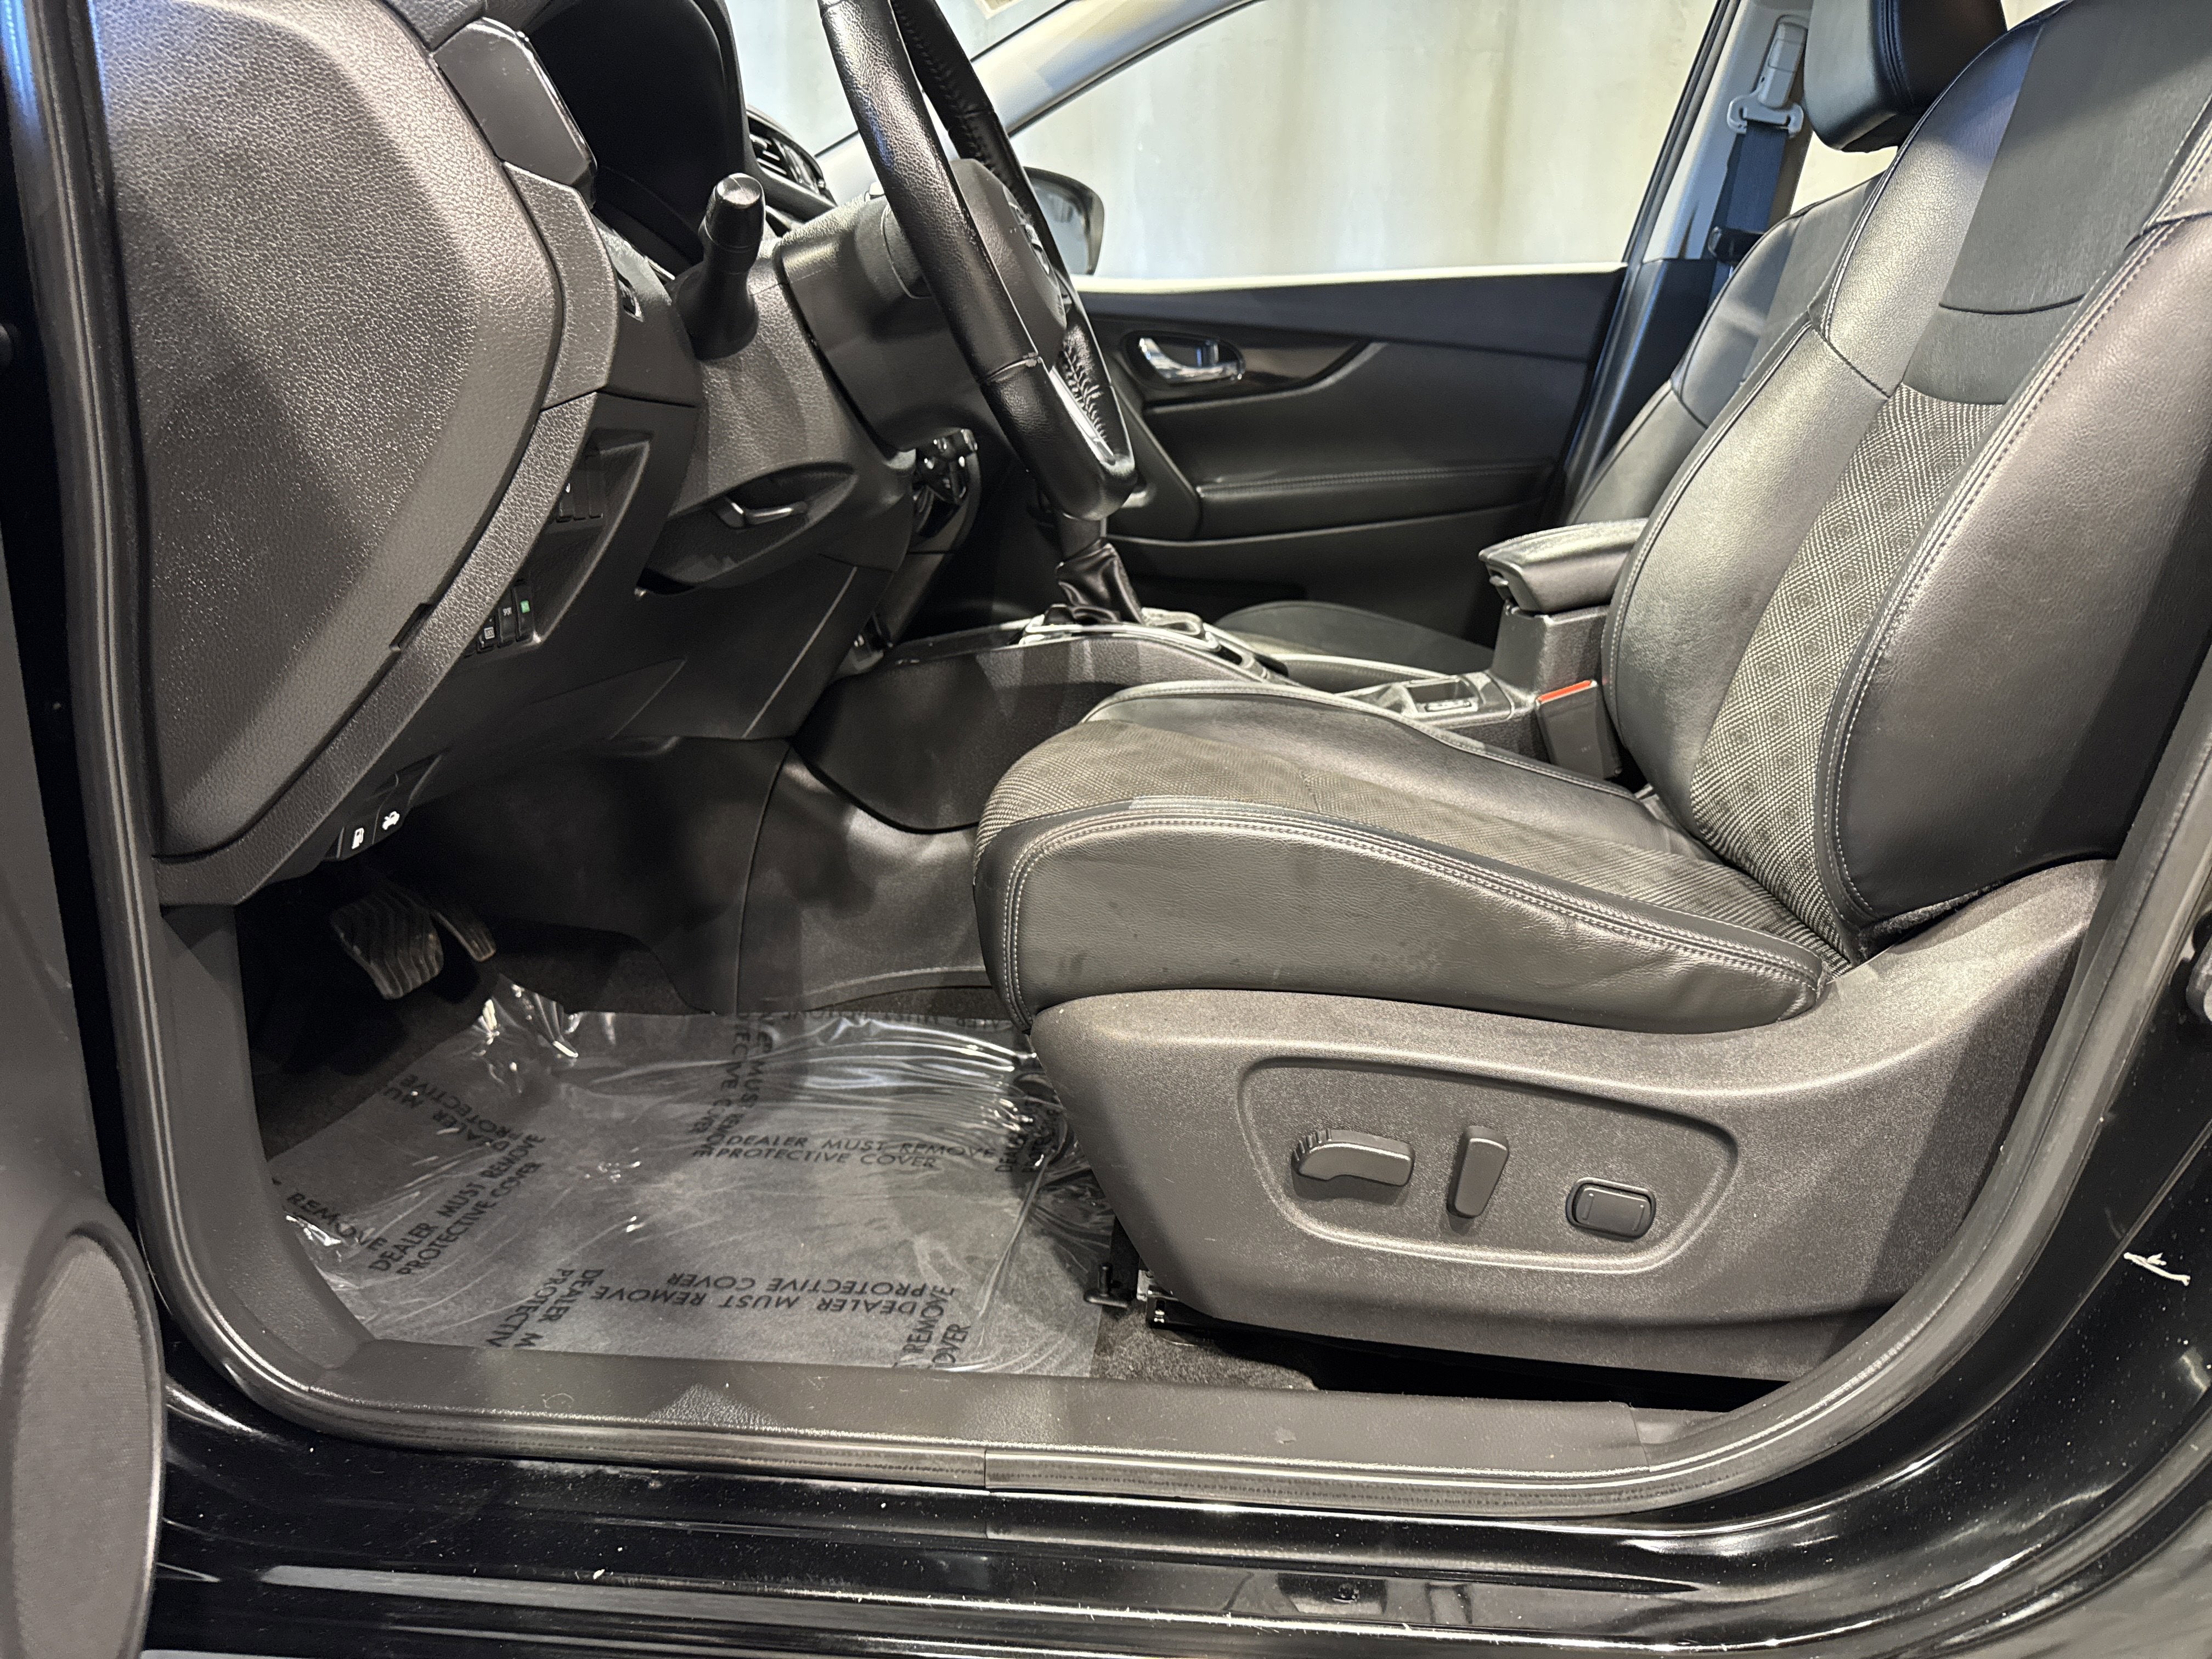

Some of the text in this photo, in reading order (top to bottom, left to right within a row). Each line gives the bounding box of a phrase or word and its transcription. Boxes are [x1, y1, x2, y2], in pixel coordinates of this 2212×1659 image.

[715, 1148, 938, 1169] PROTECTIVE COVER
[726, 1135, 809, 1148] DEALER
[821, 1138, 884, 1152] MUST
[368, 1134, 546, 1272] DEALER MUST REMOVE
[396, 1162, 545, 1275] PROTECTIVE COVER
[537, 1268, 605, 1323] DEALER
[589, 1285, 917, 1316] DEALER MUST REMOVE
[667, 1272, 927, 1297] PROTECTIVE COVER
[902, 1286, 955, 1355] REMOVE
